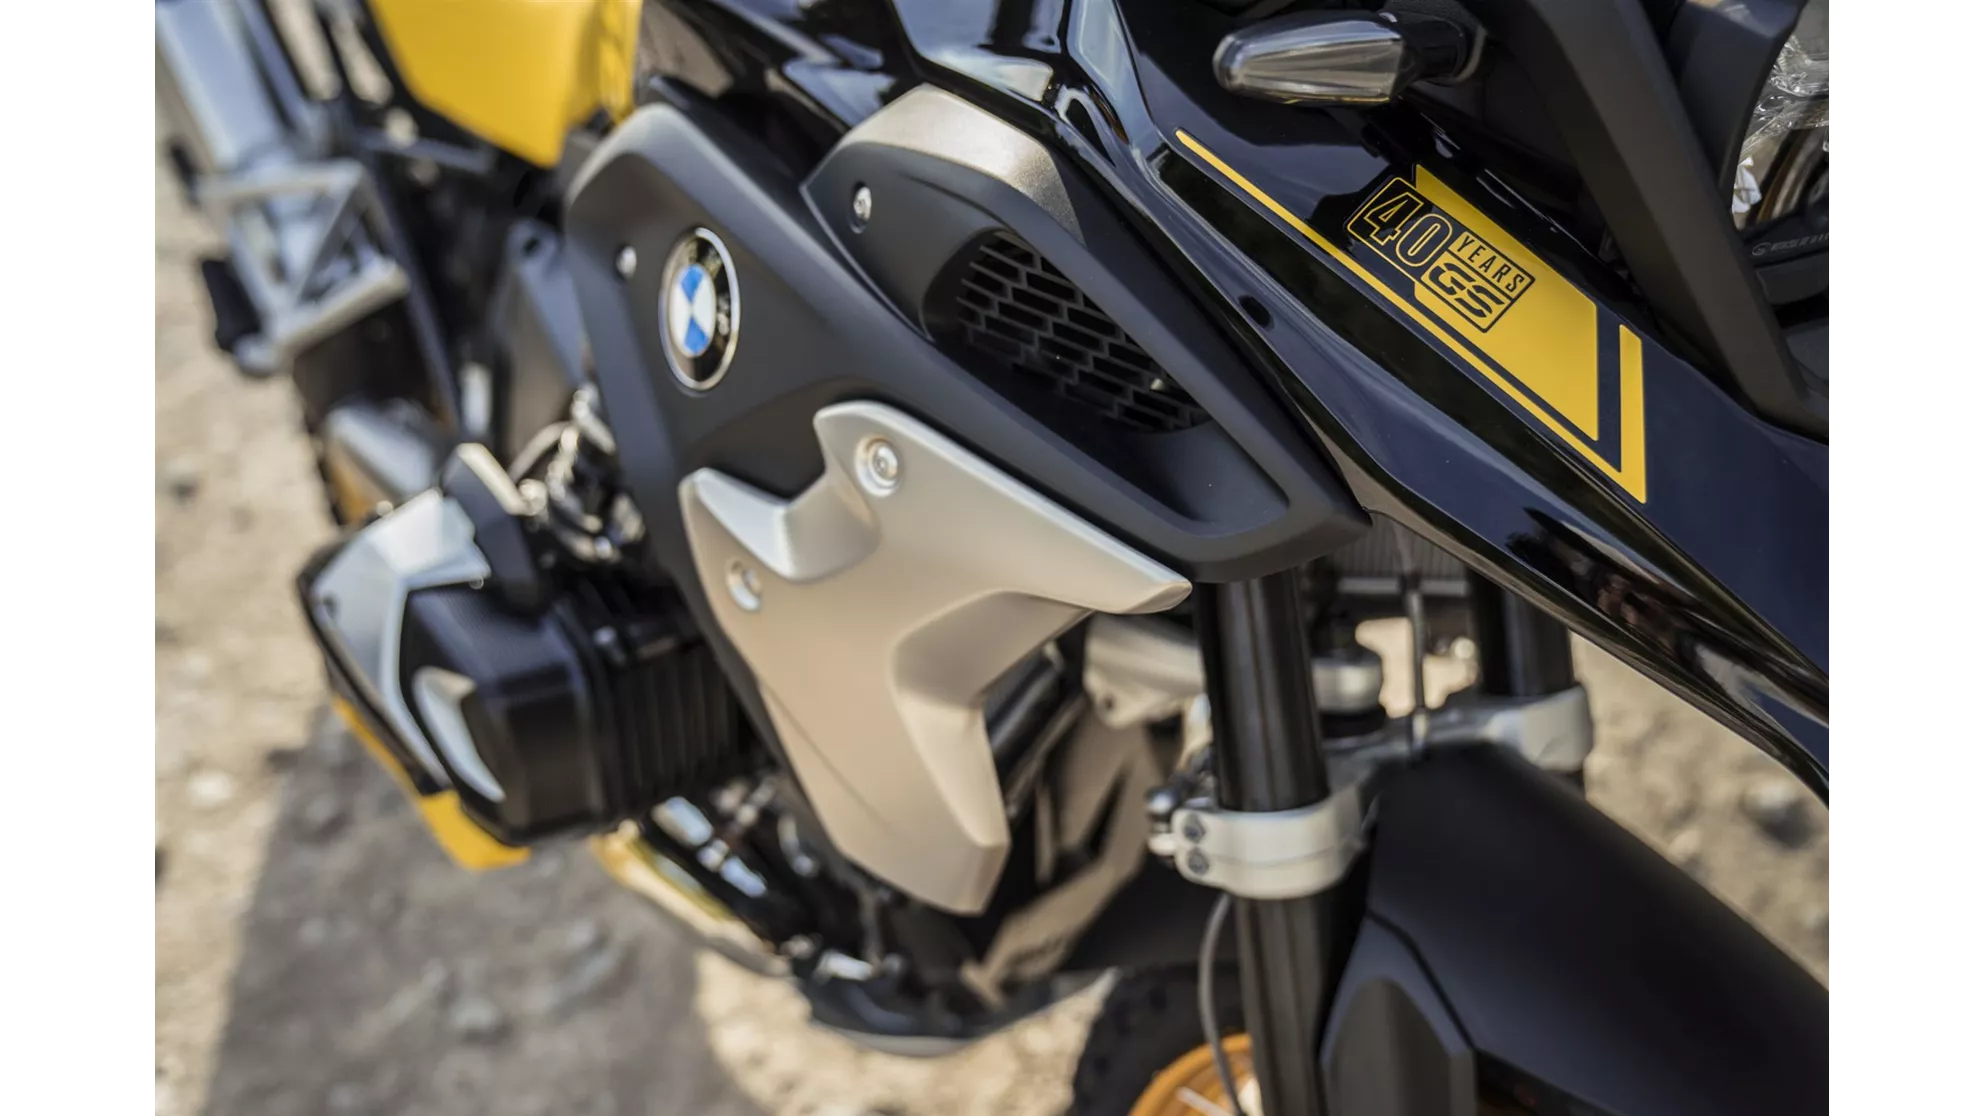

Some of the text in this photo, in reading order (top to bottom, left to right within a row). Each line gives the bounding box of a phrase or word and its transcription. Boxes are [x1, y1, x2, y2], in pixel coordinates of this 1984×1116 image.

[1364, 192, 1525, 293] 40 YEARS
[1428, 262, 1506, 318] GS
